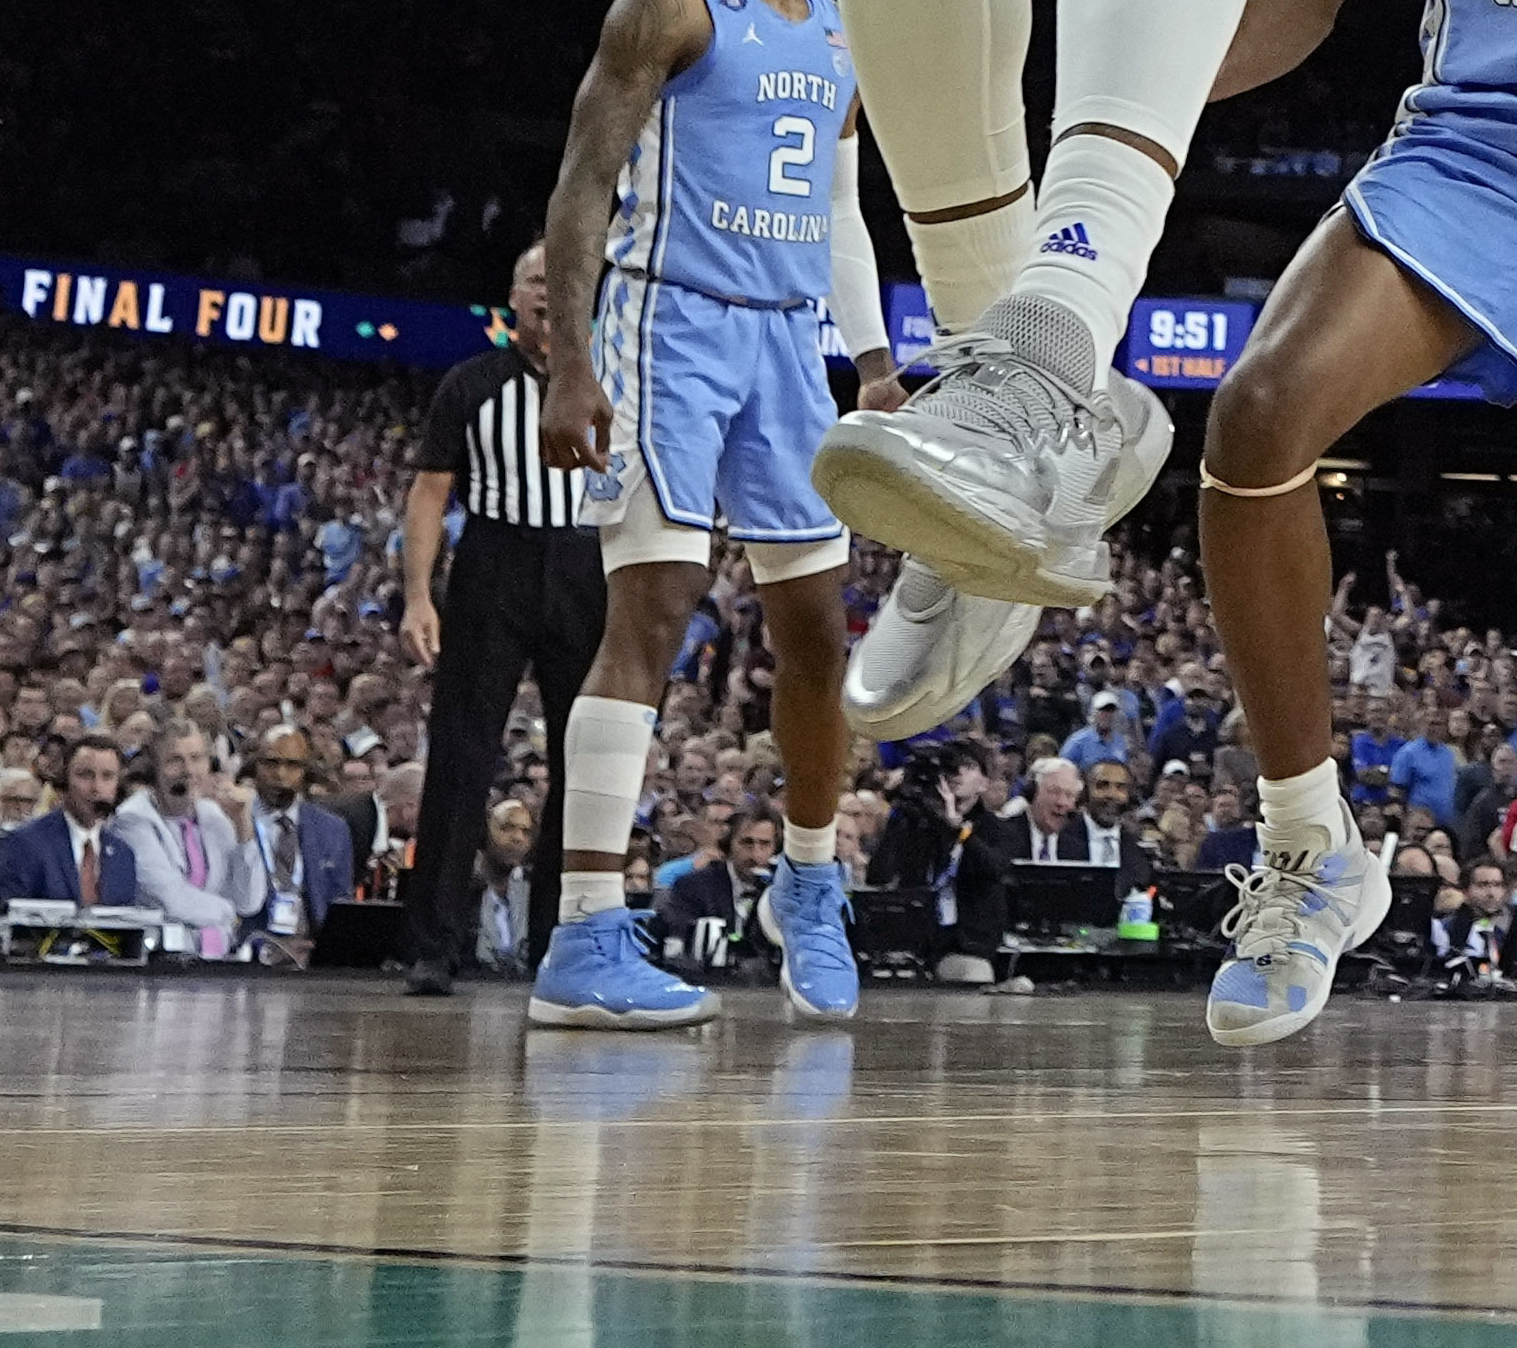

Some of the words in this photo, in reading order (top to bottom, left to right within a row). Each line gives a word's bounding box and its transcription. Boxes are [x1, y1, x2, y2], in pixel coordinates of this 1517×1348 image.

[756, 71, 836, 110] NORTH
[768, 115, 815, 197] 2
[1040, 239, 1097, 261] adidas
[22, 269, 173, 333] FINAL
[195, 289, 323, 348] FOUR
[1150, 310, 1227, 350] 9:51
